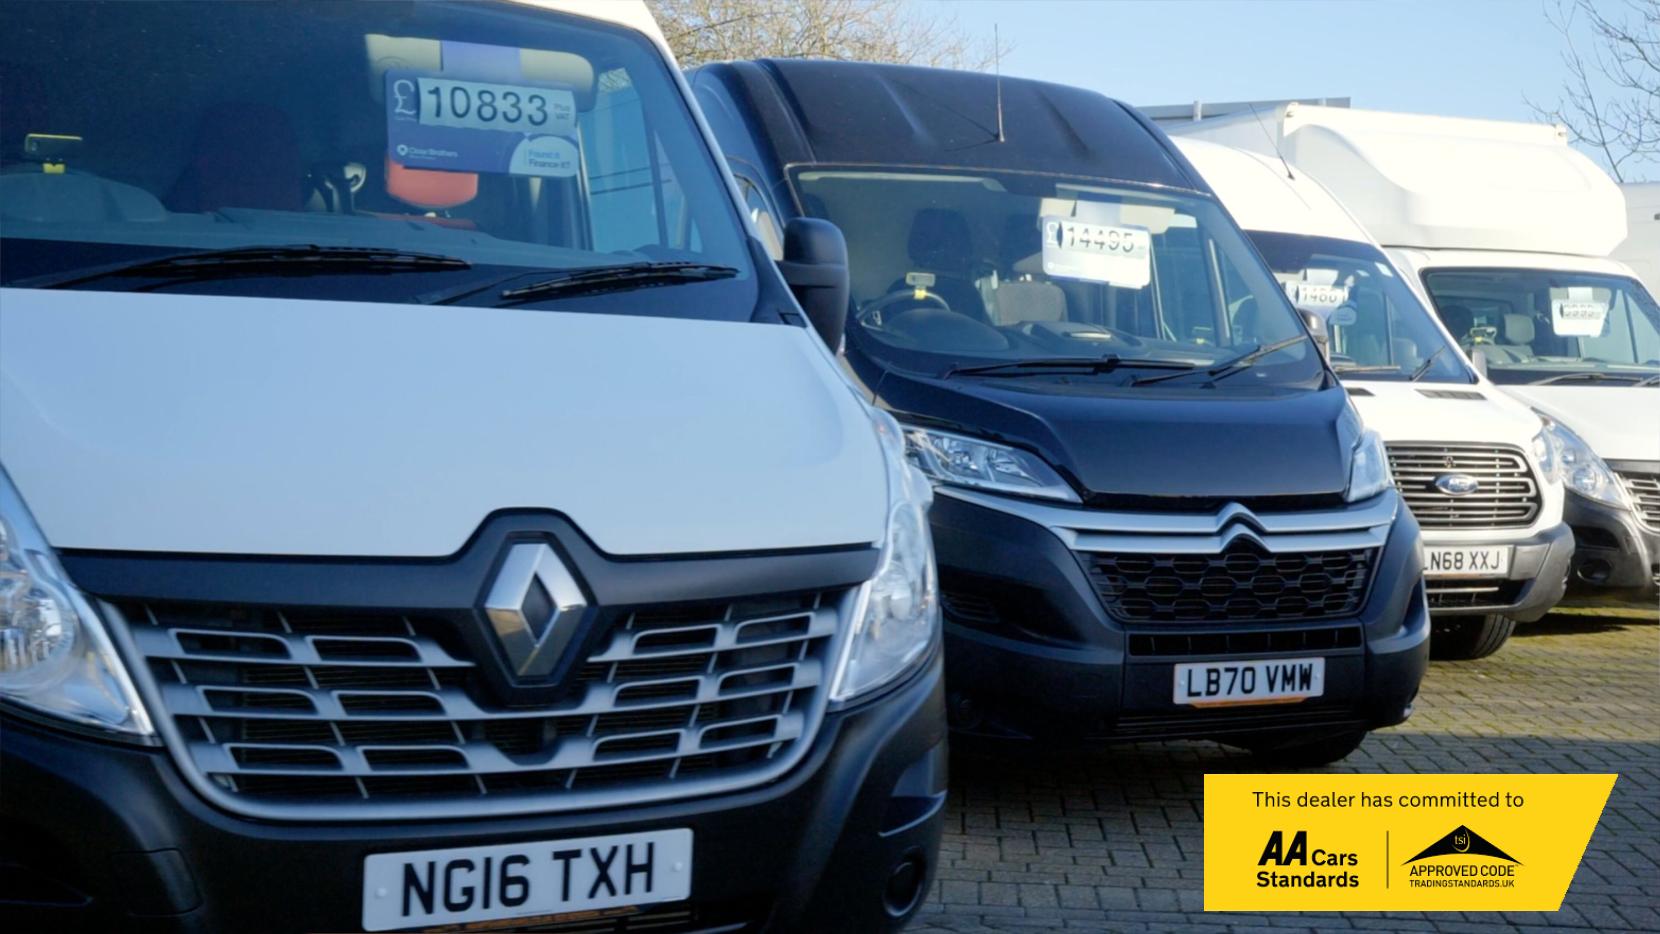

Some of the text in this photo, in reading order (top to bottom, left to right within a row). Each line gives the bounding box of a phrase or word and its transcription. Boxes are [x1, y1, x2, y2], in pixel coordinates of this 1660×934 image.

[427, 86, 548, 126] 10833
[1067, 227, 1135, 254] 14495
[1423, 551, 1500, 570] N68 XXJ
[1187, 658, 1313, 697] LB70 VMW
[402, 842, 655, 917] NG16 TXH
